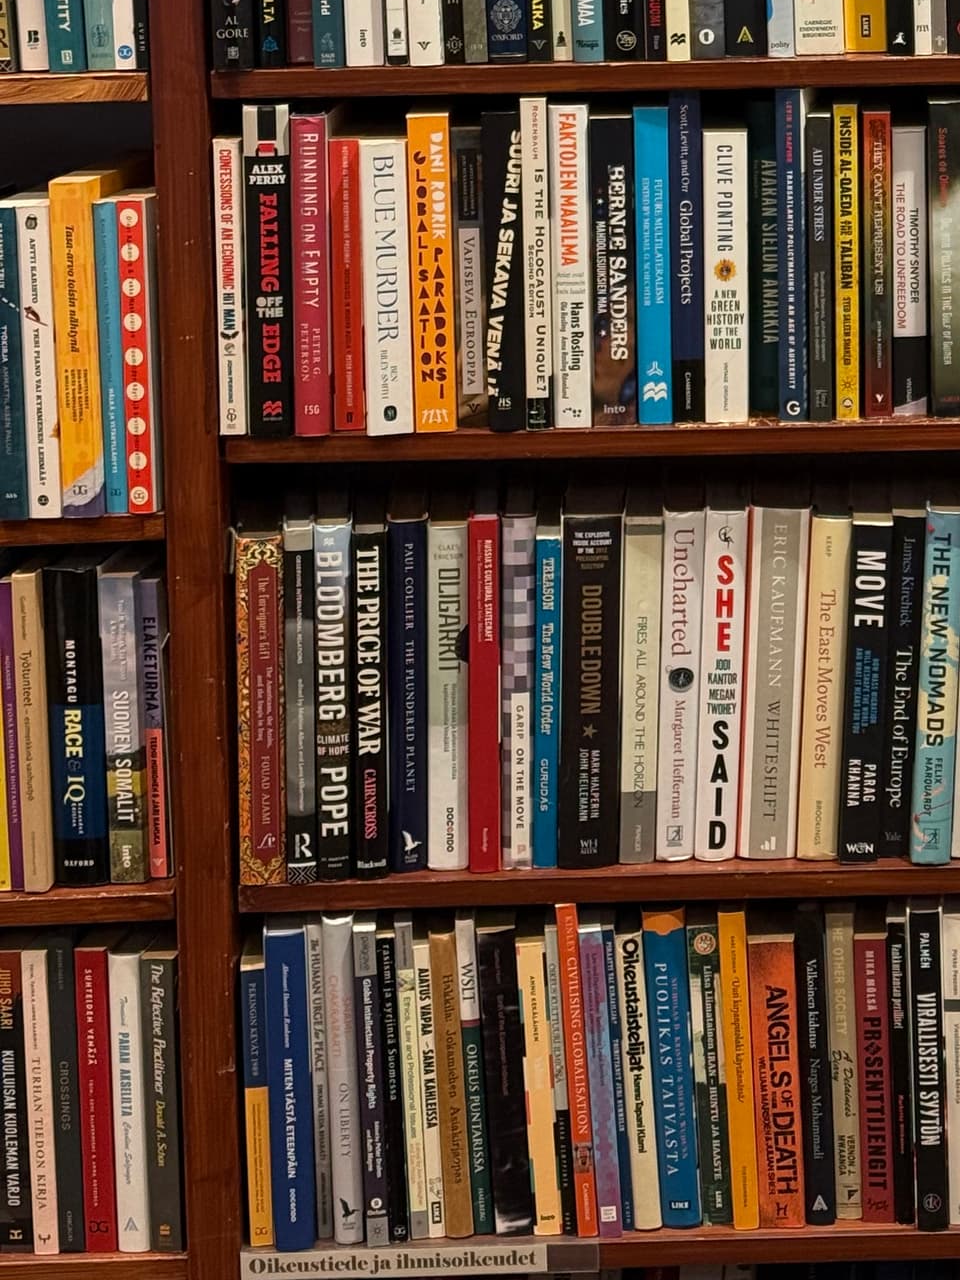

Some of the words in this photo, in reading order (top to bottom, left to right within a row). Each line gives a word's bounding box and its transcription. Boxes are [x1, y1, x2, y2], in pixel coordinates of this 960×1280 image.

[249, 175, 287, 185] PERRY
[251, 164, 283, 175] ALEX
[558, 112, 577, 194] FAKTOJEN
[717, 144, 733, 185] CLIVE
[373, 155, 397, 223] BLUE
[607, 164, 626, 251] BERNIE
[259, 193, 280, 293] FALLING
[560, 195, 578, 267] MAAILMA
[717, 192, 733, 252] PONTING
[256, 296, 283, 307] OFF
[375, 228, 399, 343] MURDER
[609, 256, 628, 361] SANDERS
[711, 301, 740, 311] GREEN
[714, 290, 720, 299] A
[721, 290, 737, 299] NEW
[256, 308, 284, 319] THE
[707, 314, 745, 325] HISTORY
[713, 327, 722, 337] OF
[724, 326, 738, 337] THE
[262, 323, 282, 384] EDGE
[710, 338, 742, 350] WORLD
[356, 546, 380, 593] THE
[932, 533, 951, 582] THE
[670, 527, 696, 657] Uncharted
[715, 555, 735, 652] SHE
[853, 550, 887, 629] MOVE
[931, 586, 949, 640] NEW
[315, 550, 350, 721] BLOOMBERG
[357, 597, 381, 665] PRICE
[357, 669, 381, 697] OF
[707, 672, 738, 685] KANTOR
[715, 659, 731, 670] JODI
[707, 703, 737, 714] TWOHEY
[709, 689, 736, 701] MEGAN
[925, 647, 948, 748] NOMADS
[64, 710, 83, 758] RACE
[111, 691, 132, 757] SUOMEN
[317, 747, 326, 756] OF
[328, 746, 350, 756] HOPE
[357, 700, 382, 757] WAR
[63, 776, 86, 804] IQ
[115, 759, 134, 823] SOMALIT
[320, 766, 349, 838] POPE
[708, 720, 729, 850] SAID
[622, 939, 643, 1072] Oikeustaistelijat
[765, 985, 793, 1088] ANGELS
[780, 1090, 793, 1107] OF
[772, 1110, 799, 1195] DEATH
[249, 1254, 368, 1275] Oikeustiede
[370, 1255, 392, 1274] ja
[396, 1250, 537, 1271] ihmisoikeudet
